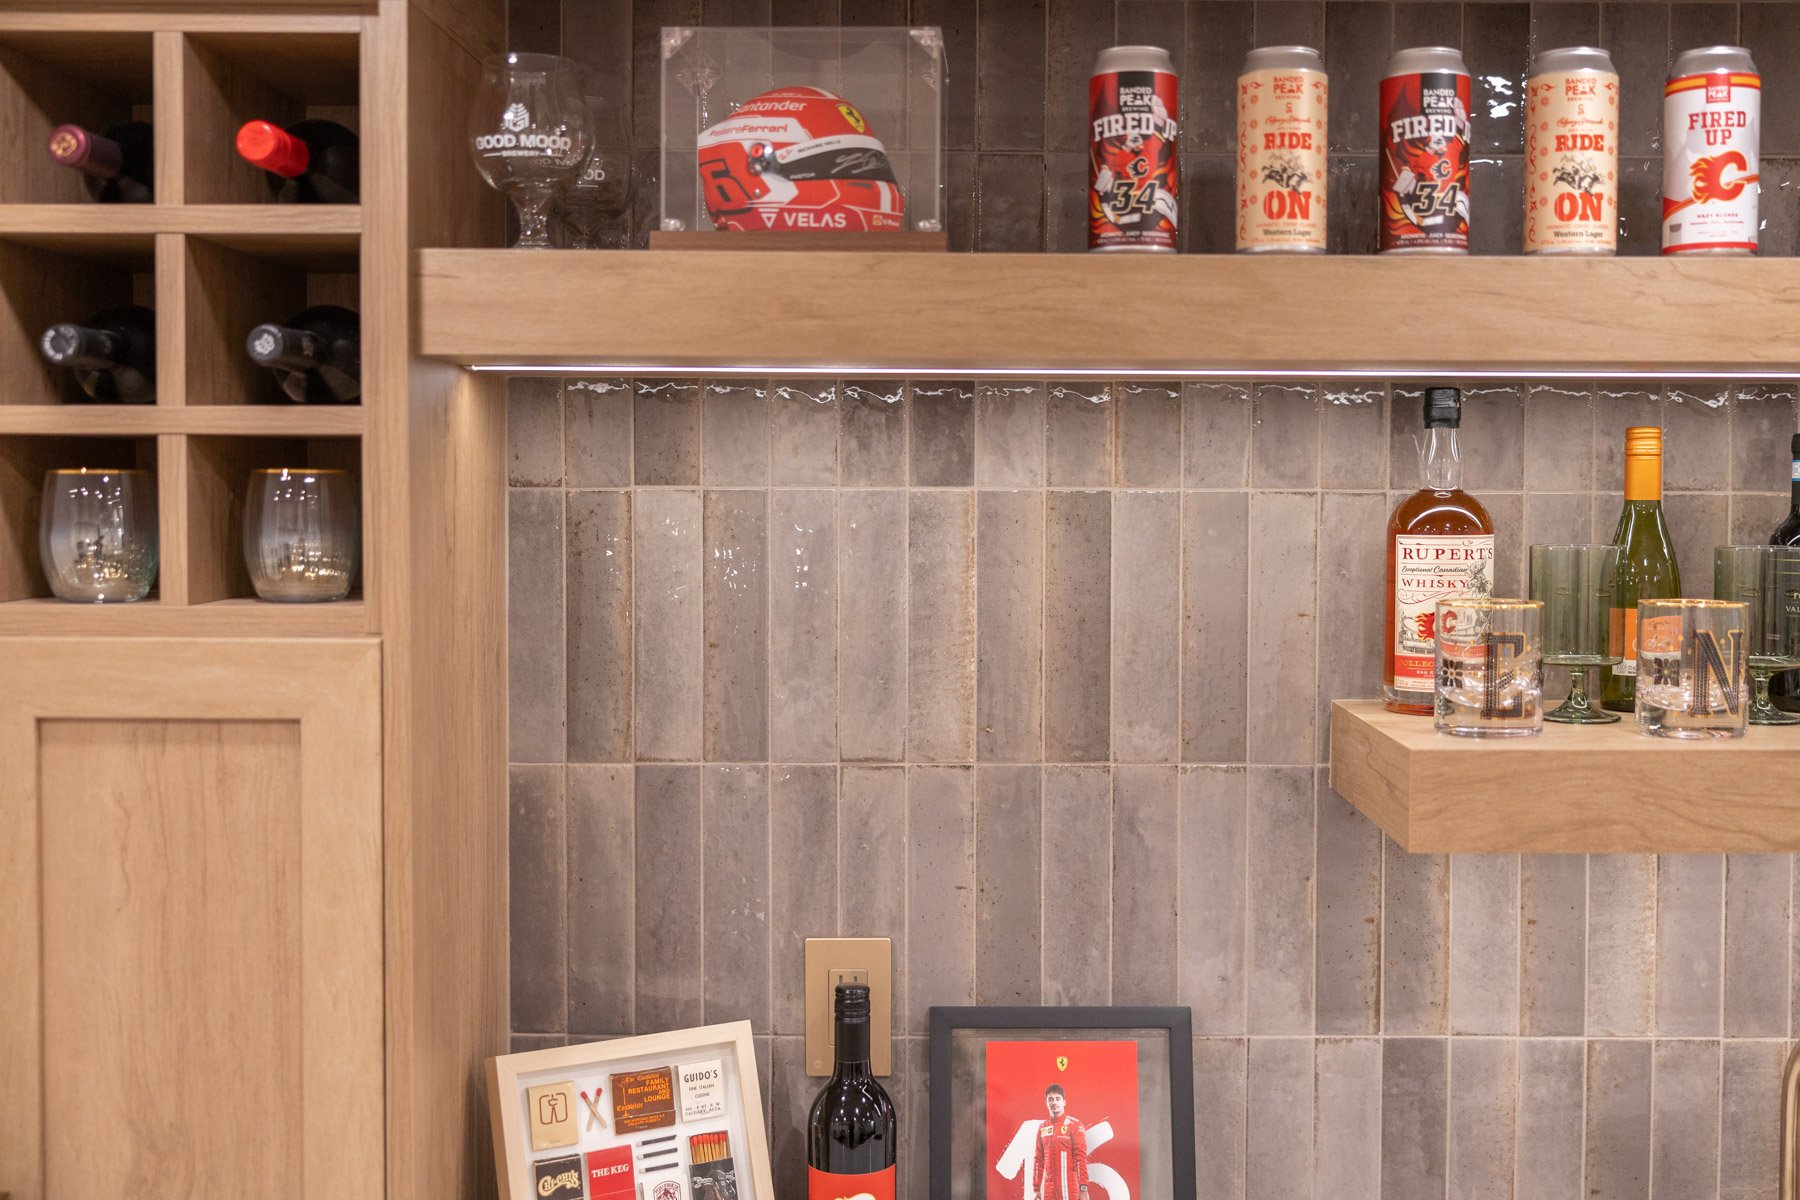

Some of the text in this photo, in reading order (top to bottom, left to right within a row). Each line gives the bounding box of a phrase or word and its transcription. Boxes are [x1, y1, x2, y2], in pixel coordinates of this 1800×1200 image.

[1119, 87, 1152, 95] BANDED
[1273, 84, 1303, 93] PEAK
[1565, 86, 1596, 96] PEAK
[1120, 95, 1152, 106] PEAK
[1423, 96, 1454, 108] PEAK
[1093, 112, 1155, 142] FIRED
[1688, 111, 1746, 130] FIRED
[1390, 114, 1456, 144] FIRED
[475, 134, 572, 150] GOOD MOOD
[1264, 132, 1312, 150] RIDE
[1555, 134, 1604, 152] RIDE
[1705, 129, 1732, 146] UP
[1109, 180, 1159, 215] 34
[1263, 190, 1312, 220] ON
[1411, 182, 1460, 216] 34
[1554, 192, 1603, 222] ON
[783, 213, 847, 228] VELAS
[1553, 230, 1603, 239] Western Lager
[1402, 547, 1493, 560] RUPERT'S
[1433, 565, 1468, 574] Canadian
[1401, 578, 1468, 588] WHISKY
[1689, 629, 1744, 717] N
[646, 1077, 669, 1086] FAMILY
[683, 1069, 718, 1083] GUIDO'S
[627, 1083, 670, 1095] RESTAURANT
[643, 1093, 671, 1103] LOUNGE
[590, 1163, 630, 1178] THE KEG
